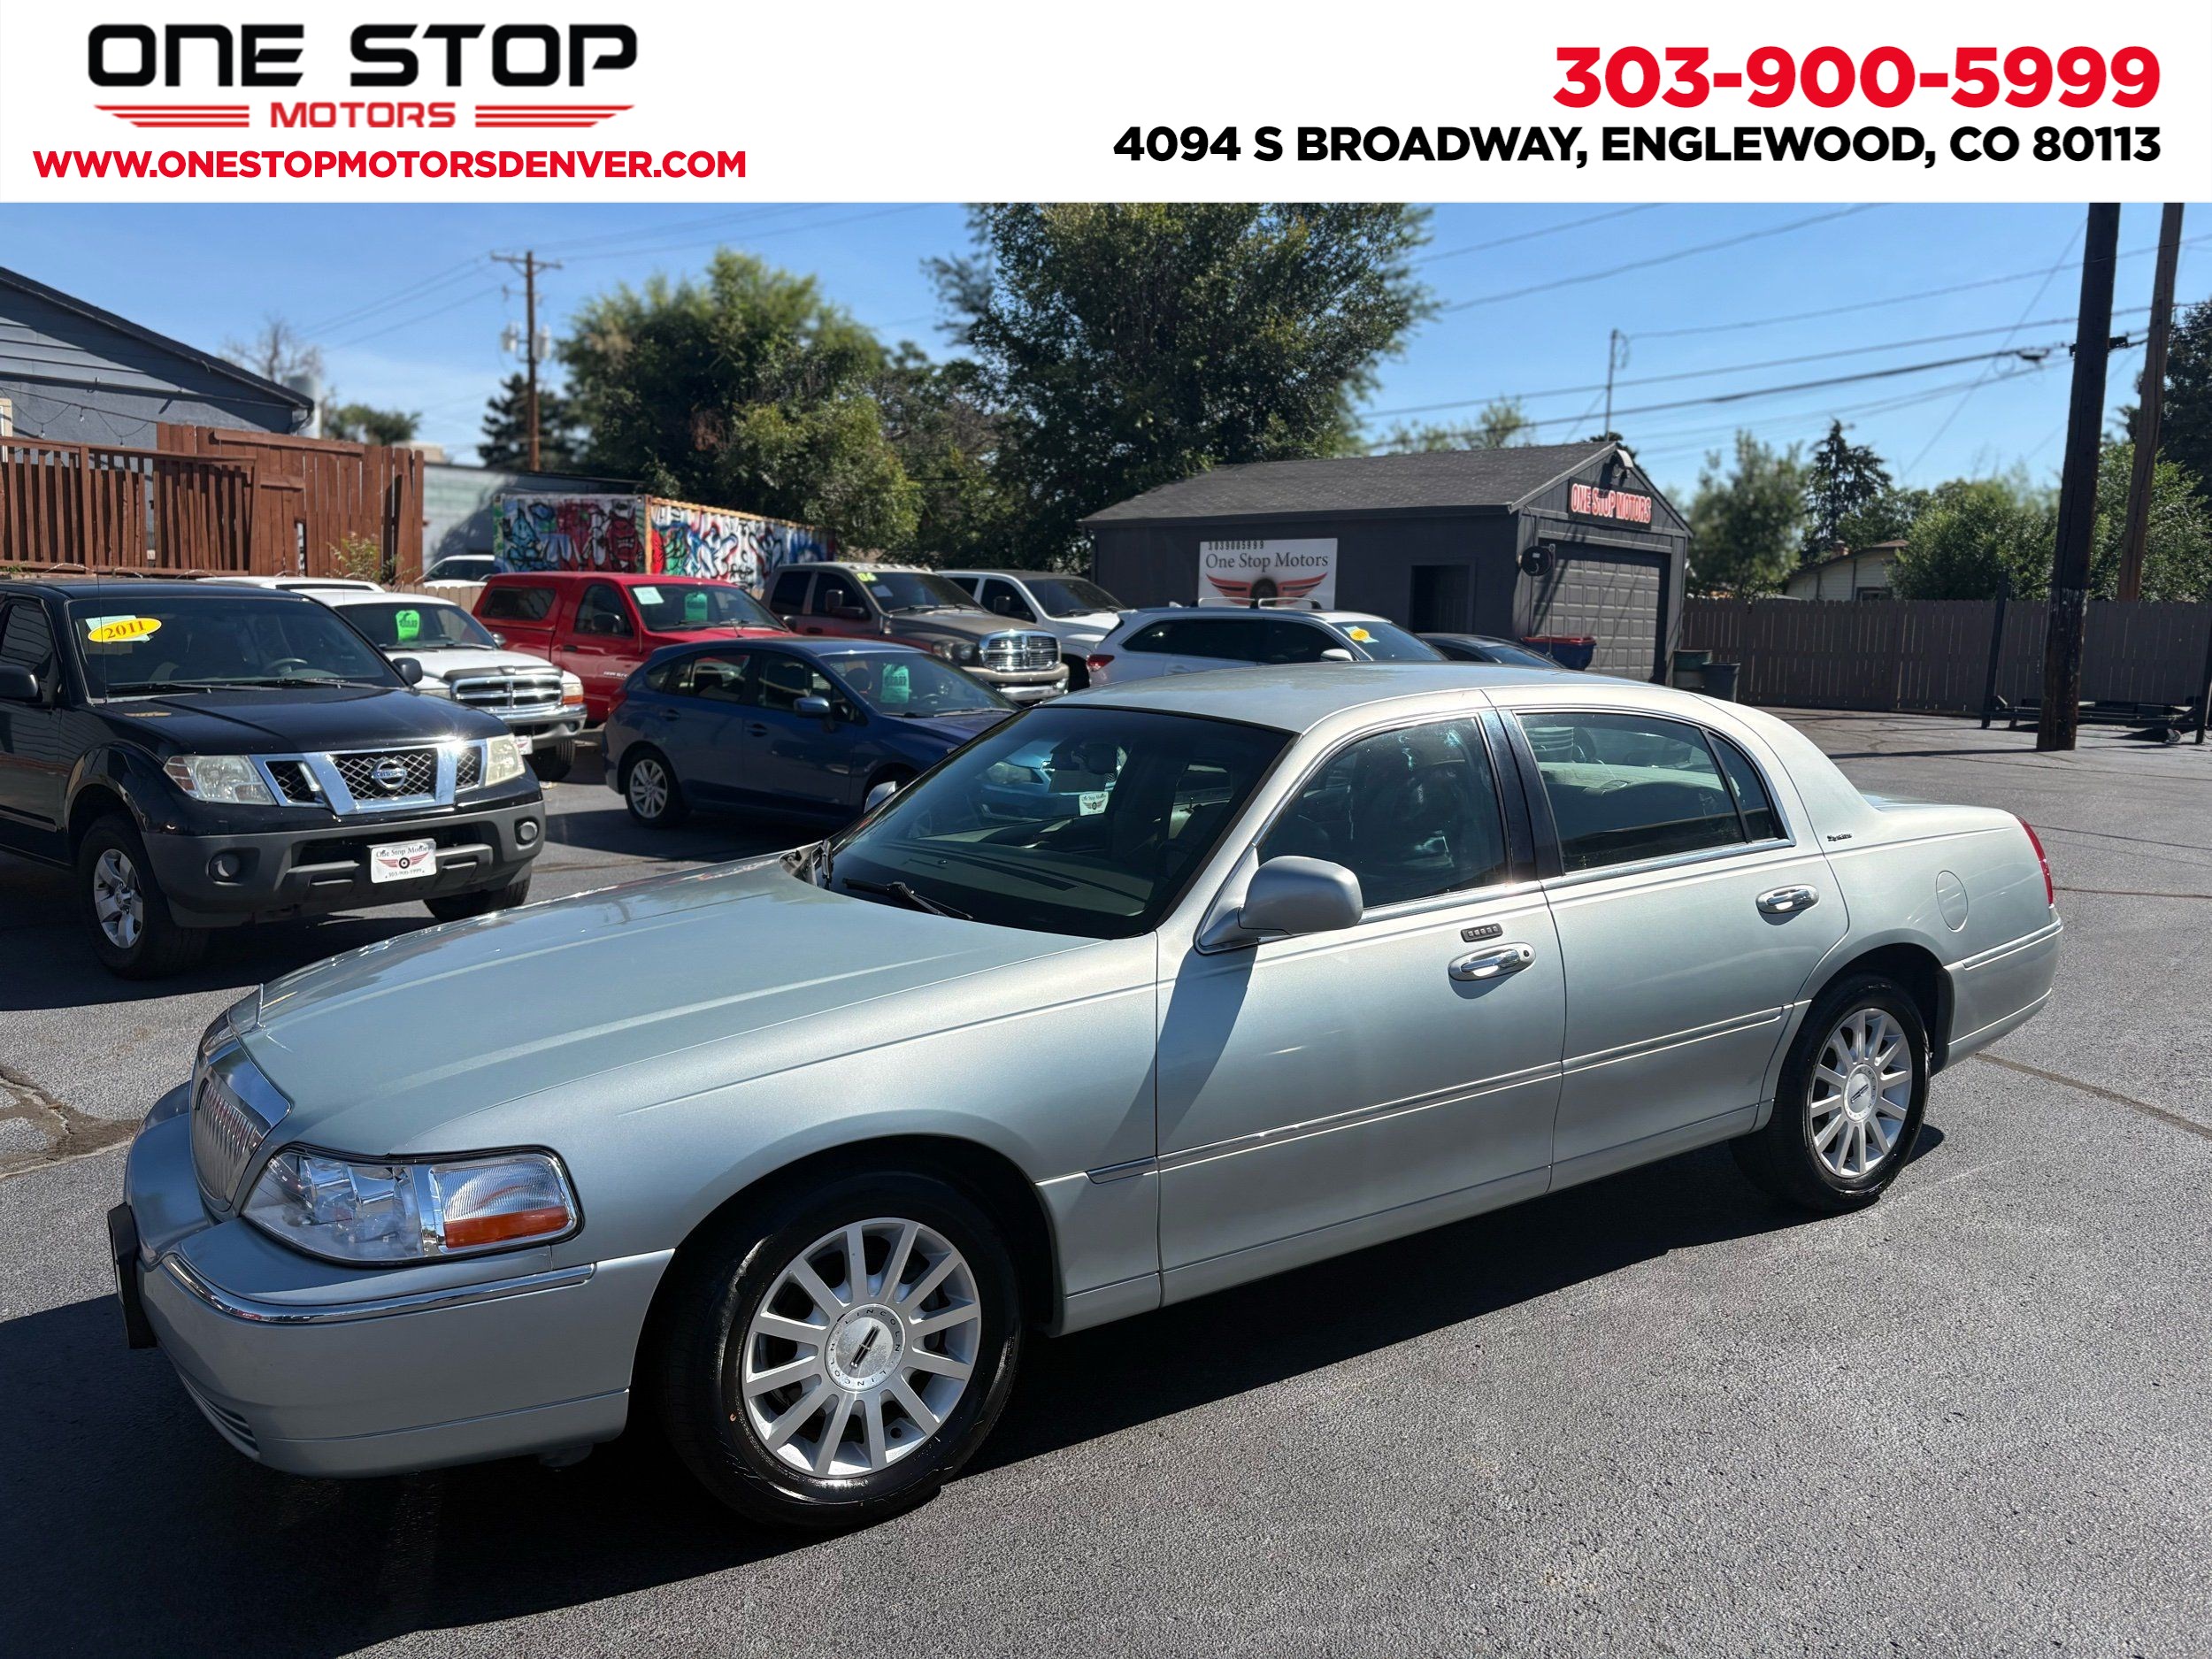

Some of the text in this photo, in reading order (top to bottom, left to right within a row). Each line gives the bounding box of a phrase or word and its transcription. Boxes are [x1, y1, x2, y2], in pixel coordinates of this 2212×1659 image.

[1571, 483, 1591, 515] ONE
[1616, 491, 1652, 524] MOTORS
[1205, 552, 1328, 573] One Stop Motors
[104, 620, 146, 640] 2011
[845, 1309, 901, 1352] LINCOLN
